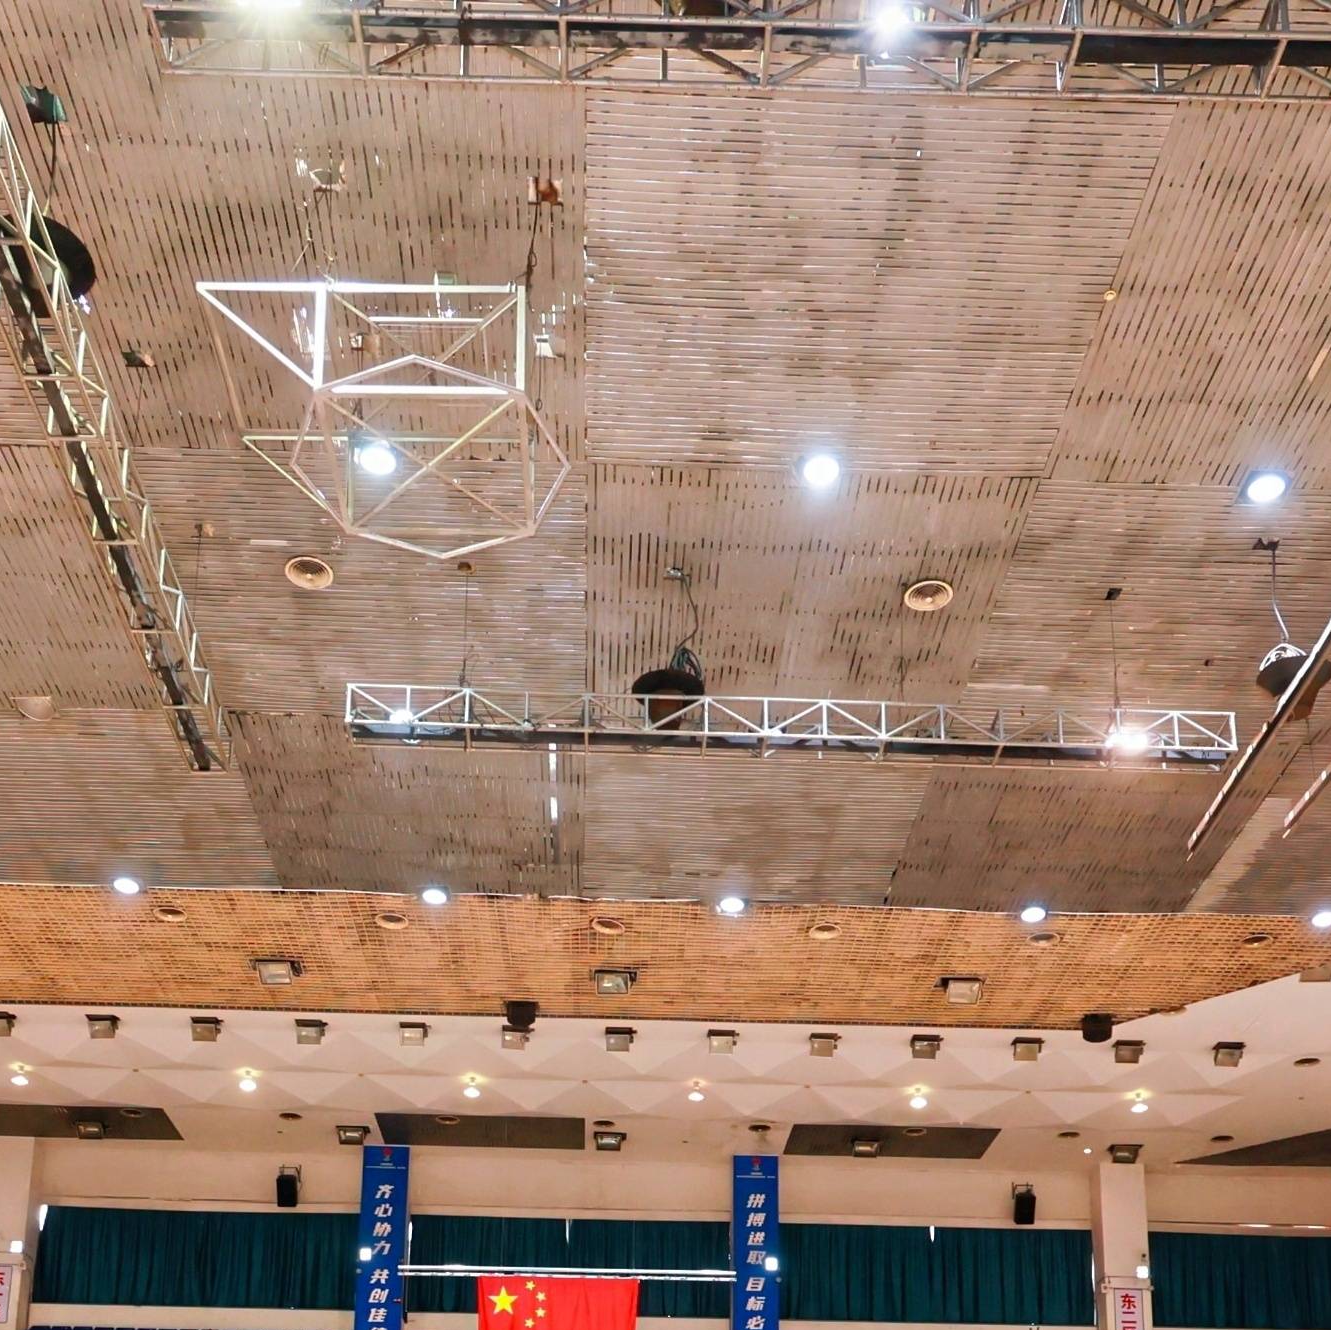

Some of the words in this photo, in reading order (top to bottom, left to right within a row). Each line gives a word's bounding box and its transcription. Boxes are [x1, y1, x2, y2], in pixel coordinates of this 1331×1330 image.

[371, 1184, 395, 1256] 齐心协力
[746, 1193, 766, 1266] 拼搏进取
